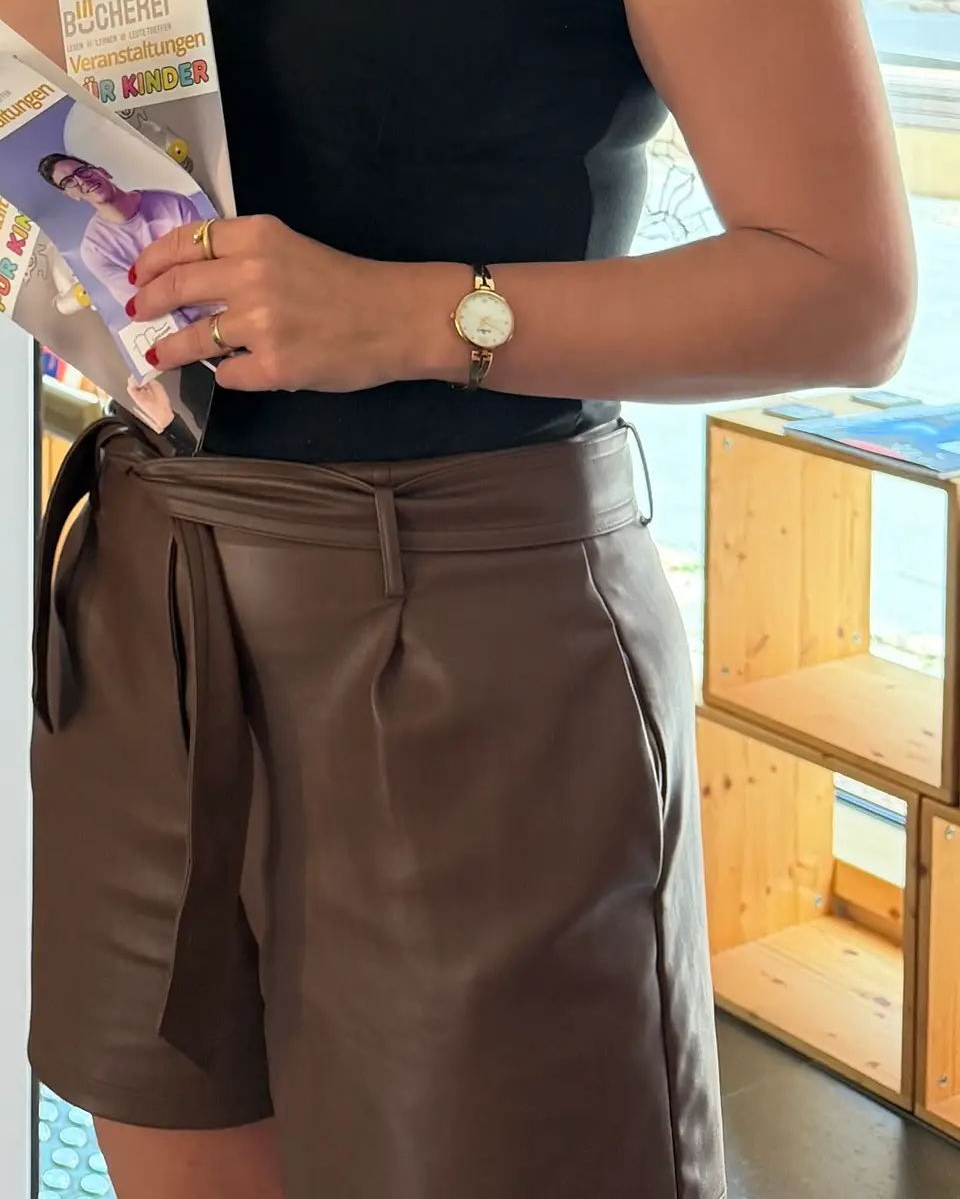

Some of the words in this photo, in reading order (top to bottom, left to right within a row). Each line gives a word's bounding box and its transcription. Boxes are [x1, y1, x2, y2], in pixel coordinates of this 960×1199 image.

[69, 31, 206, 74] Veranstaltungen
[121, 58, 210, 99] KINDER
[6, 214, 32, 257] KIN
